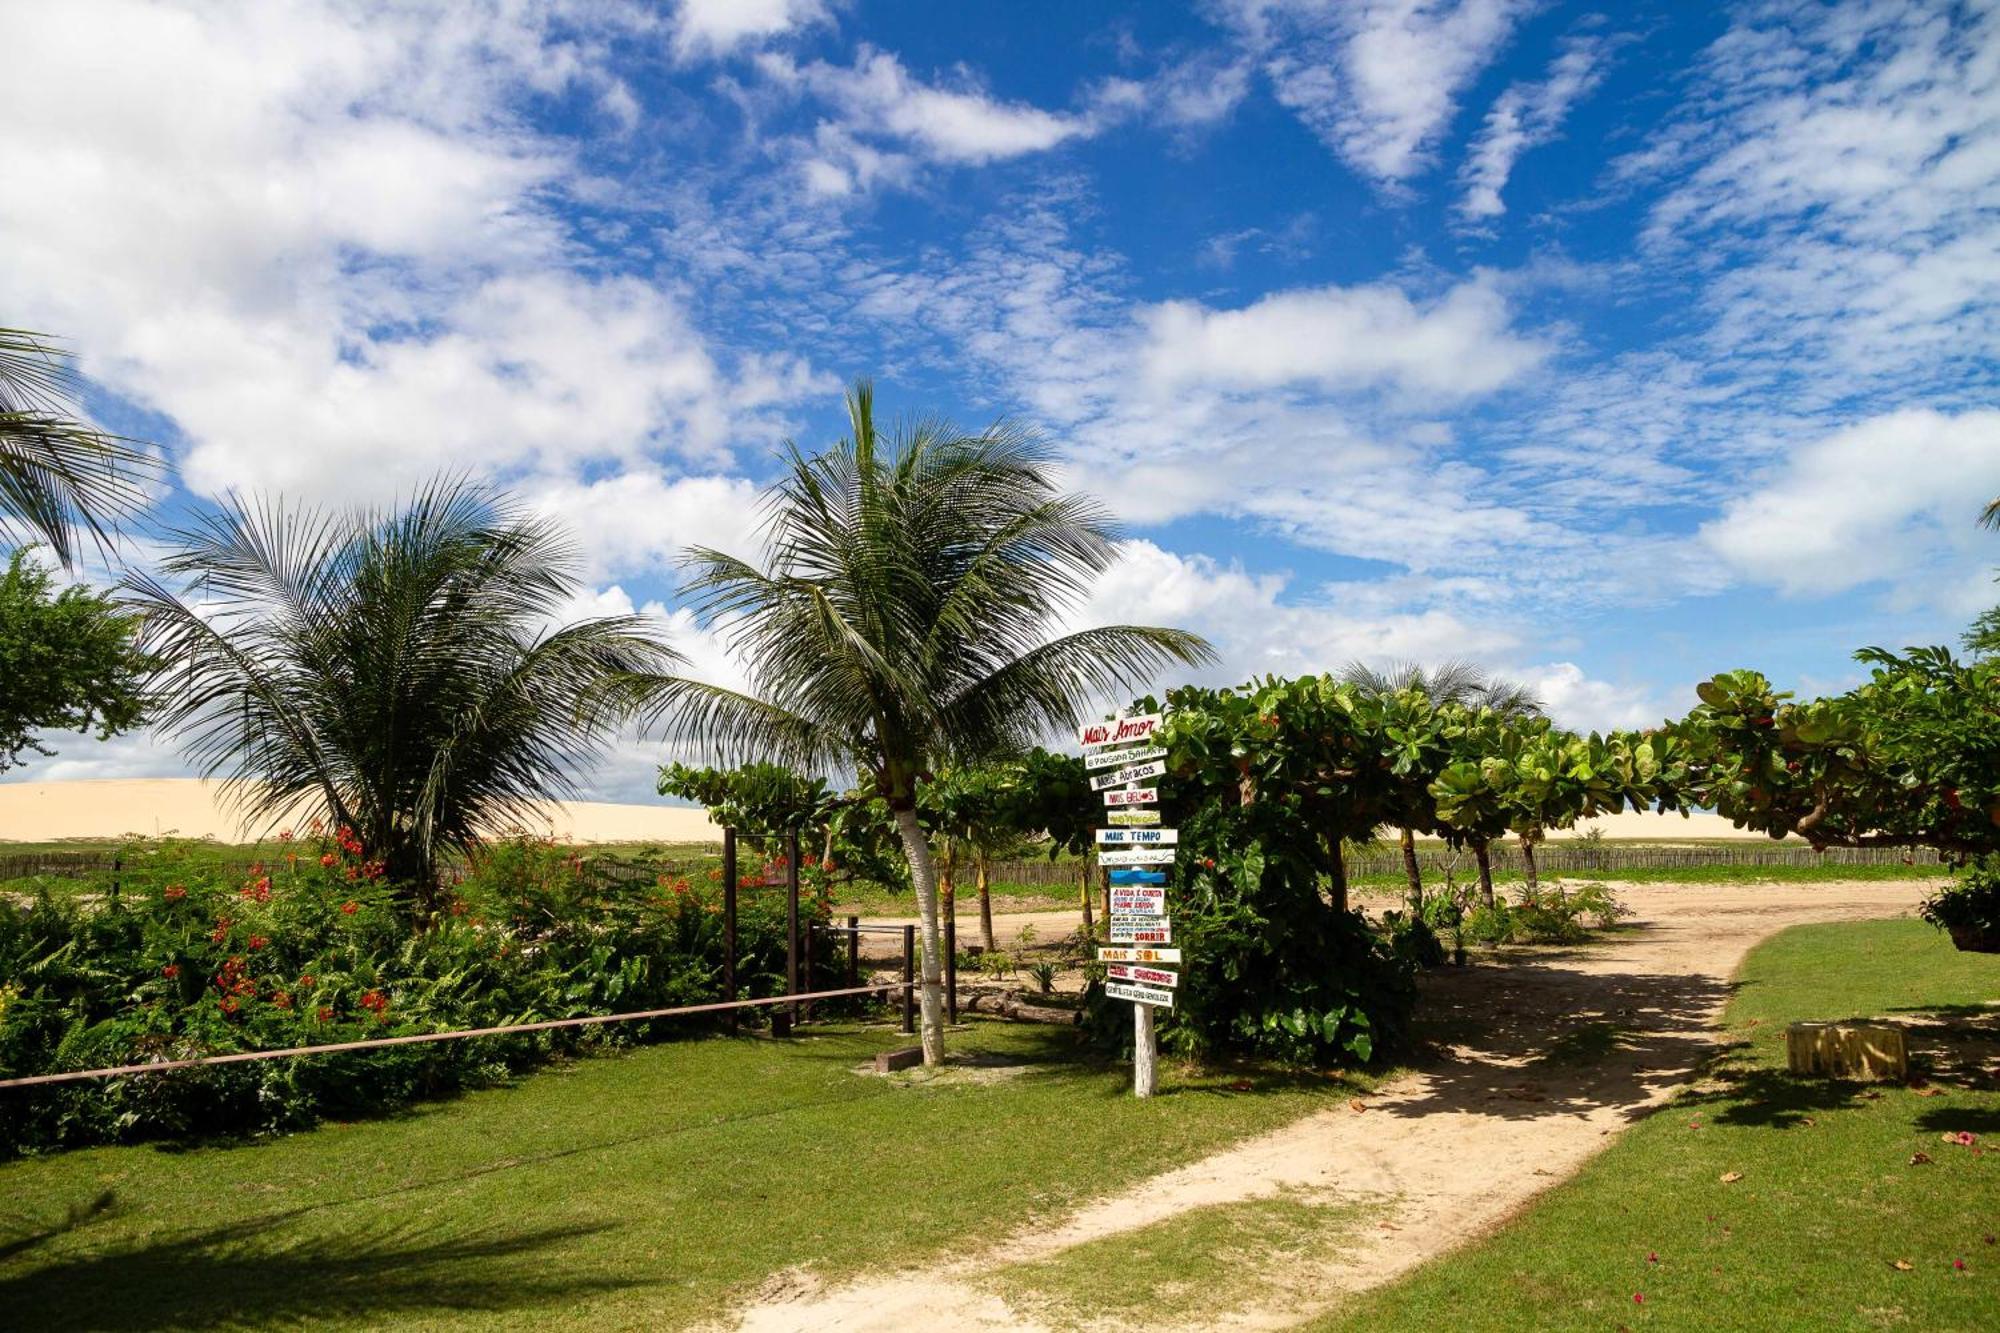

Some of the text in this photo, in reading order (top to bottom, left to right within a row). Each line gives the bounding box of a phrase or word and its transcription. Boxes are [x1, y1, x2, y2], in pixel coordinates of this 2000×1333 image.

[1081, 719, 1155, 745] Mais Amor
[1104, 831, 1161, 841] MAIS TEMPO
[1134, 932, 1165, 941] SORRIR
[1103, 950, 1128, 960] MAIS
